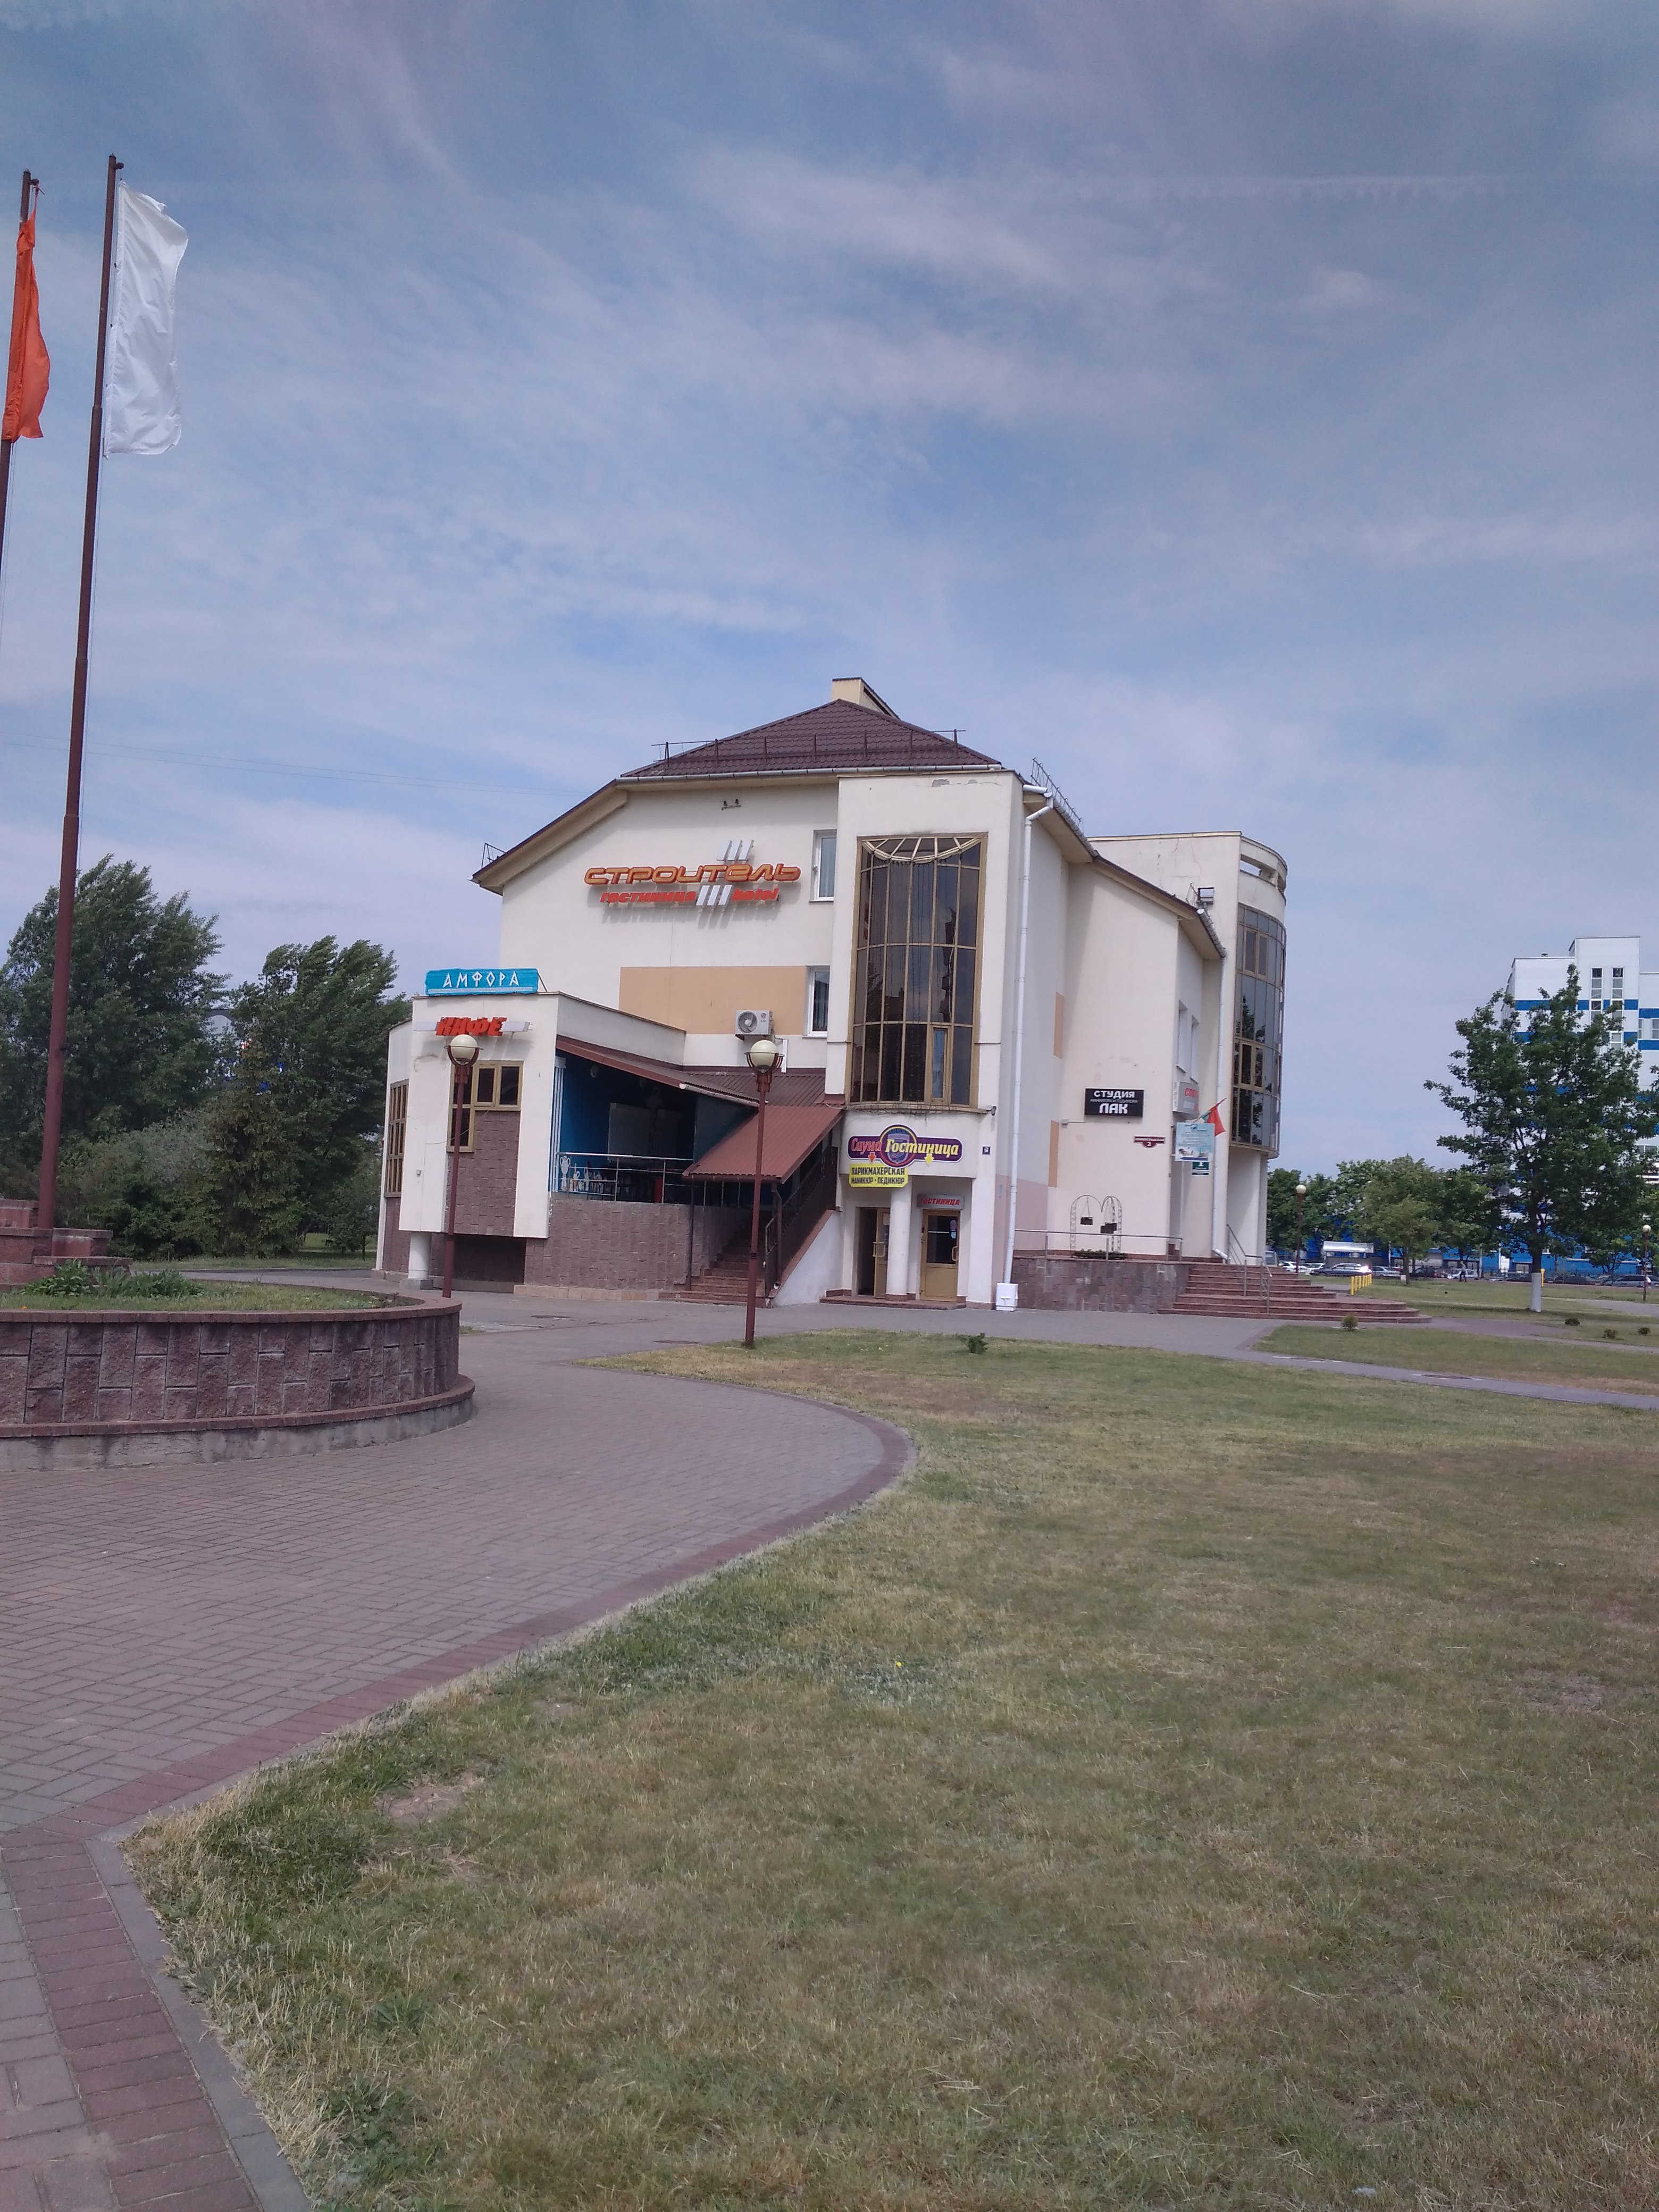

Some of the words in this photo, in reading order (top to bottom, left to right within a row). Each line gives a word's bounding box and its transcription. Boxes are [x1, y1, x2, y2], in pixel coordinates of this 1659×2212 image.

[731, 887, 779, 901] hotel
[442, 971, 519, 988] АМФОРА
[435, 1017, 507, 1036] КАФЕ
[1094, 1091, 1135, 1099] СТУДИЯ
[1099, 1103, 1128, 1114] ЛАК
[851, 1138, 882, 1155] Сауна
[885, 1139, 959, 1158] Гостиница
